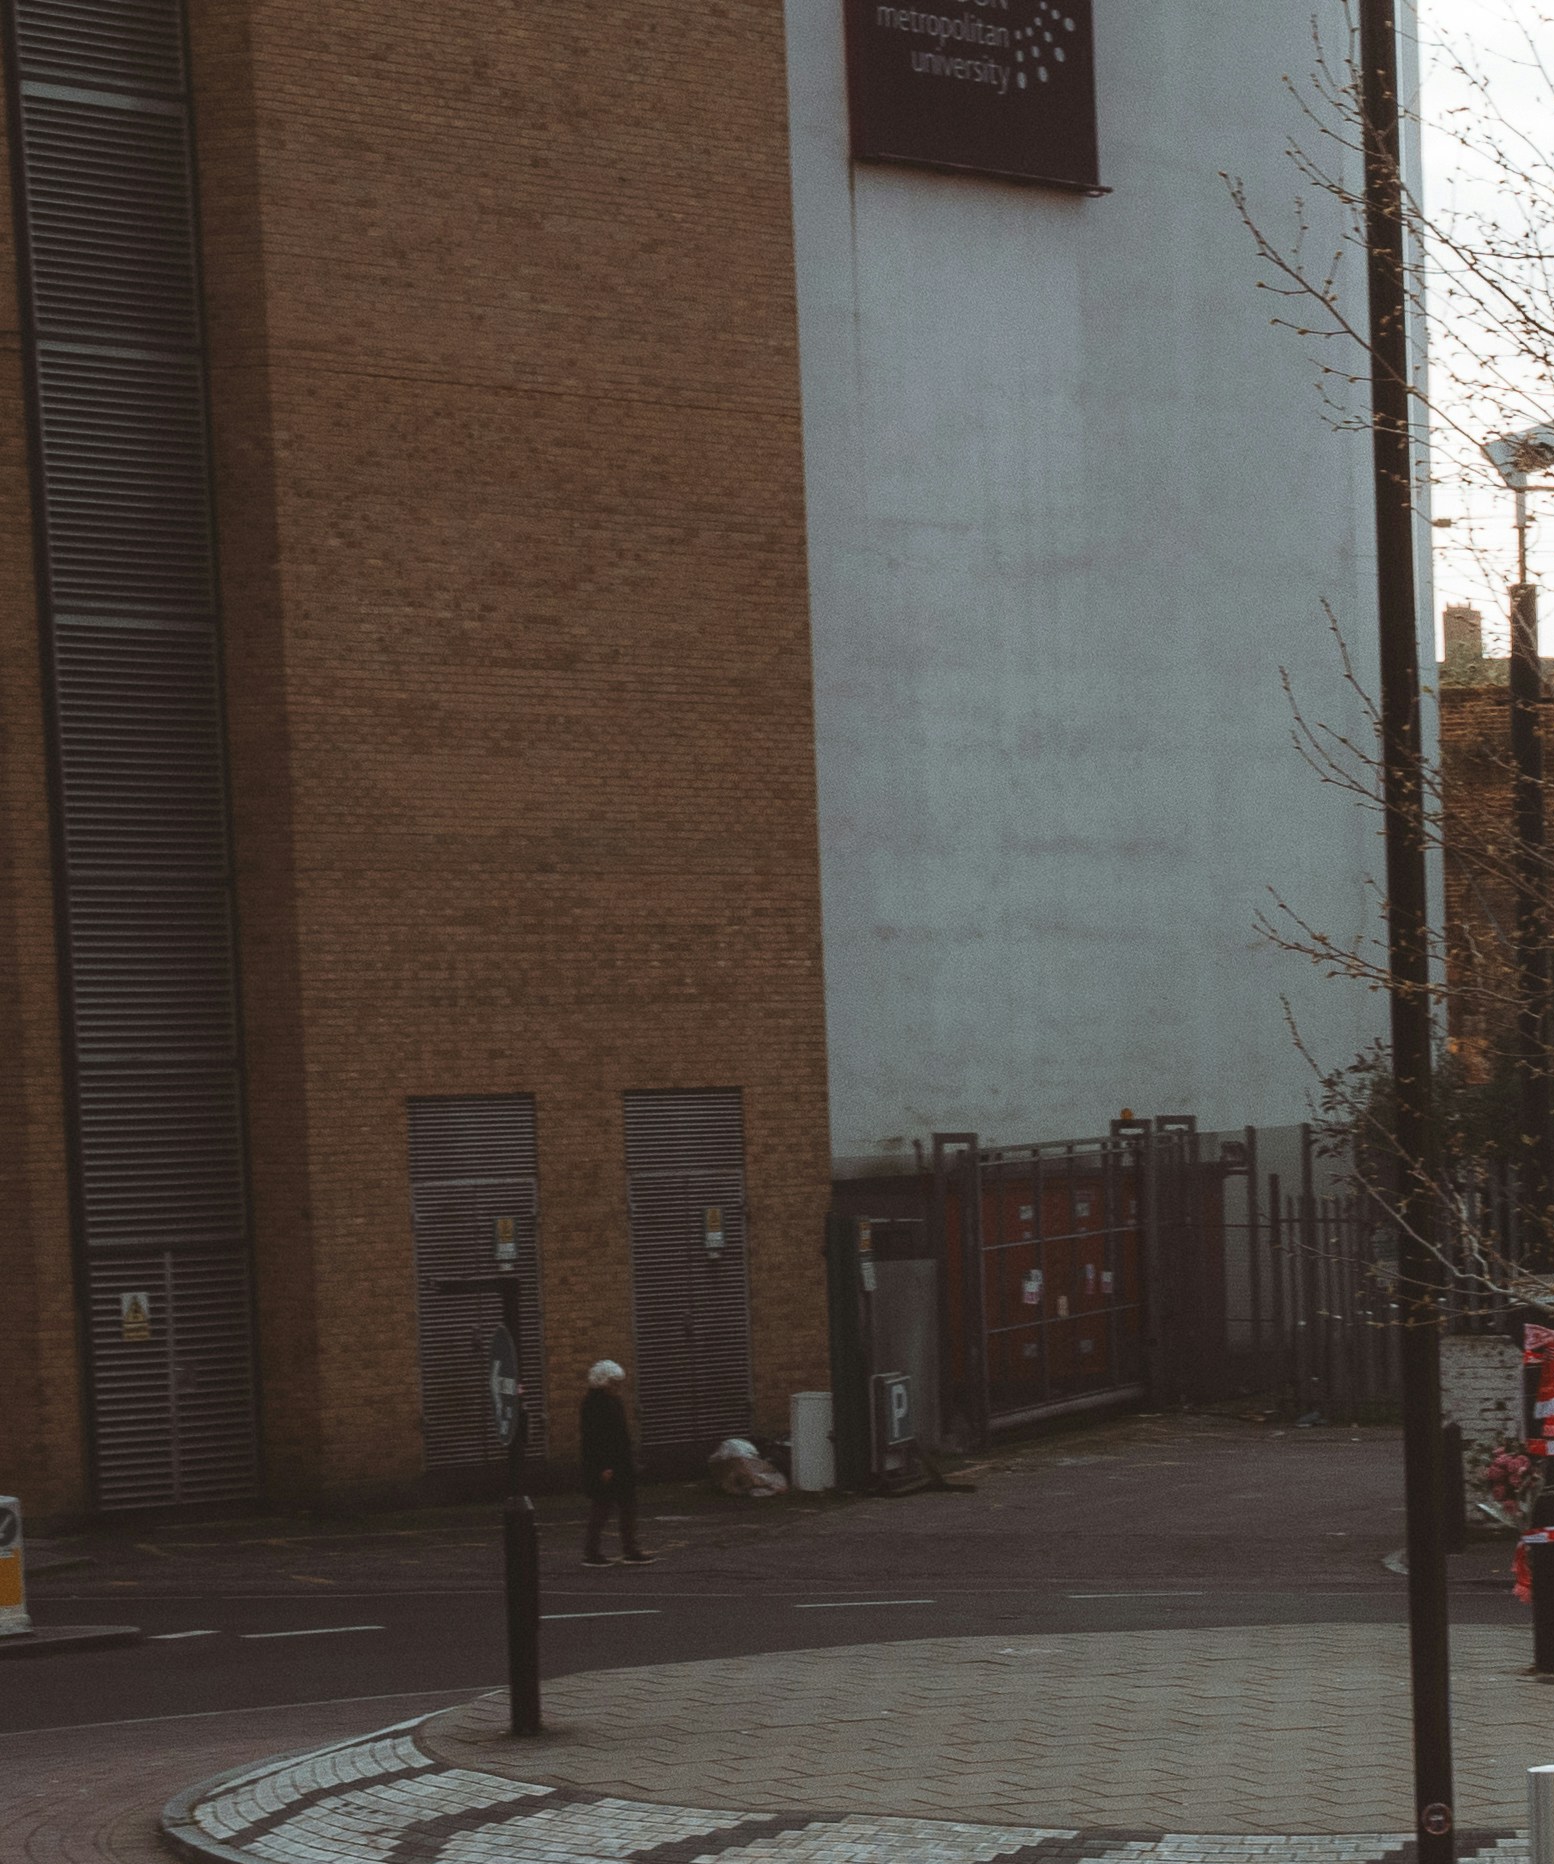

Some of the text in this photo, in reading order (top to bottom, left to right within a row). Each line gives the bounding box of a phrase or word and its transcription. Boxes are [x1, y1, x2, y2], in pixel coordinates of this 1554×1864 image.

[877, 6, 1010, 51] metropolitan
[911, 50, 1010, 95] university
[891, 1384, 907, 1439] P
